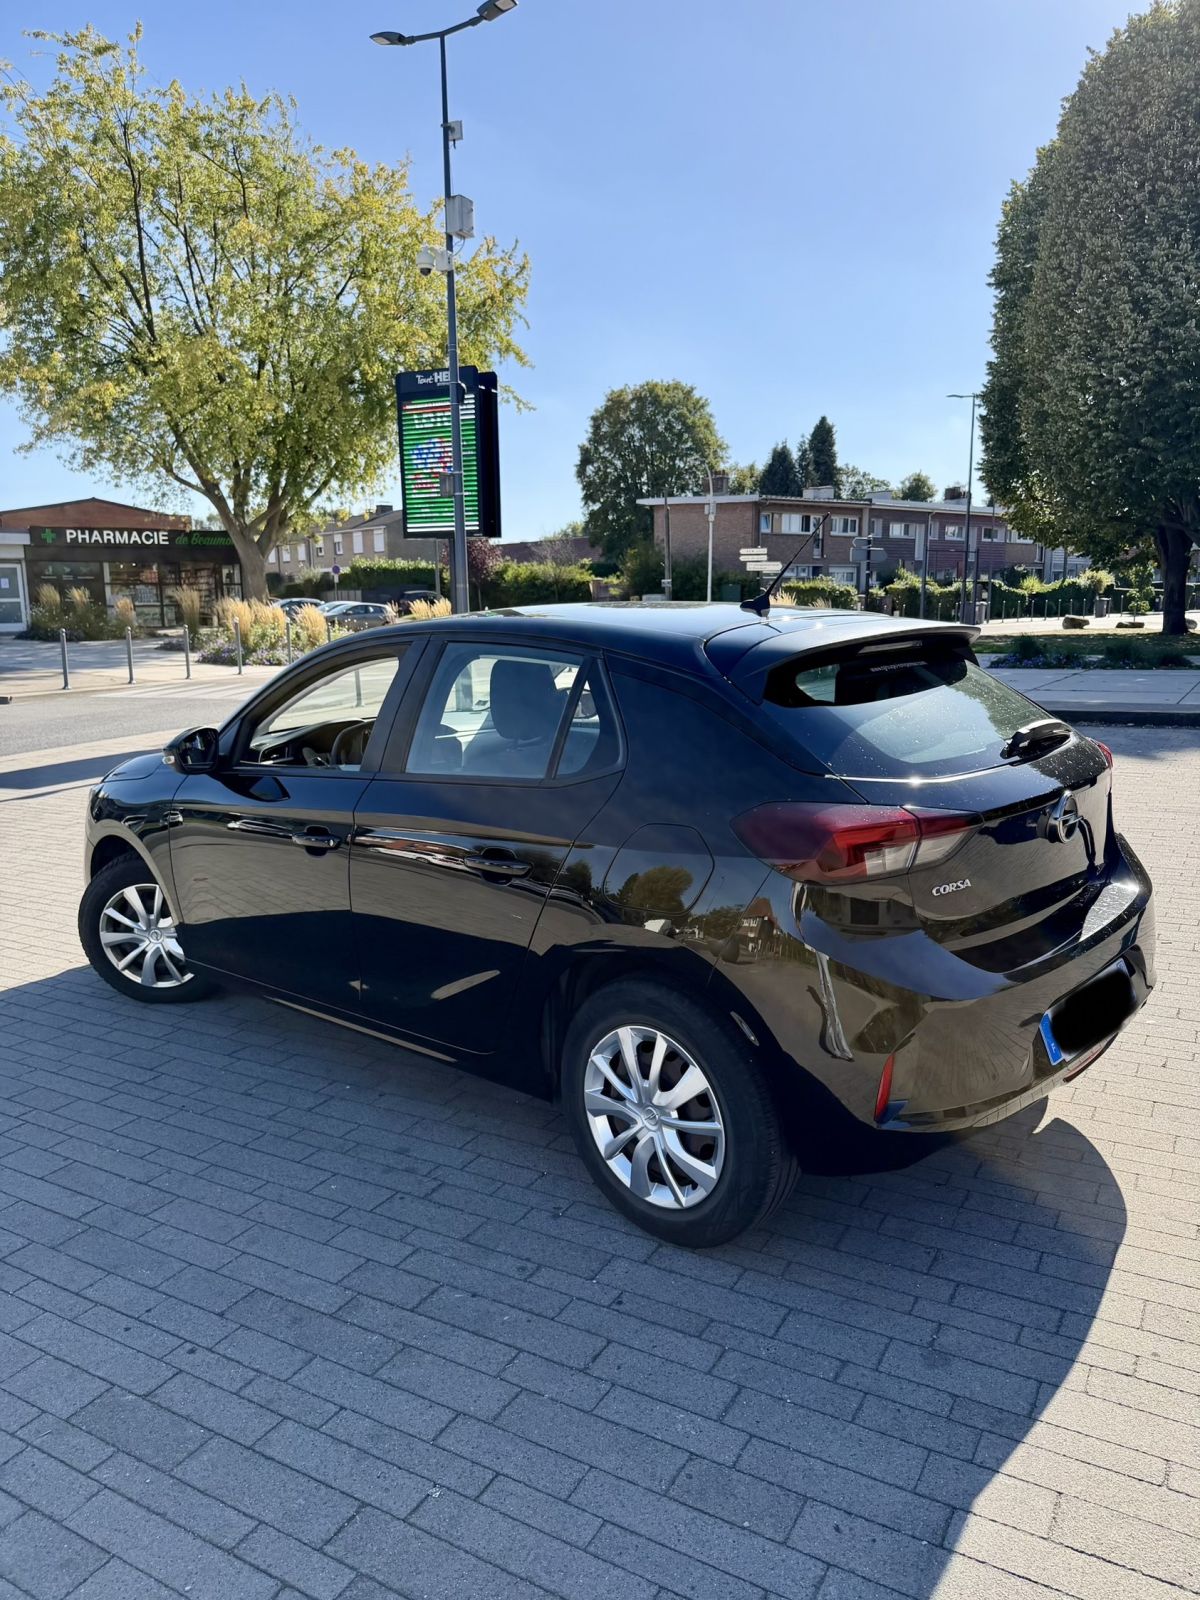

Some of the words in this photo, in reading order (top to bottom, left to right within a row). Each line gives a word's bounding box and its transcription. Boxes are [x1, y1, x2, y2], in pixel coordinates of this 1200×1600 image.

[434, 371, 450, 383] HE
[66, 529, 169, 545] PHARMACIE
[175, 533, 188, 545] de
[191, 532, 232, 545] Beaumo
[931, 879, 972, 896] CORSA
